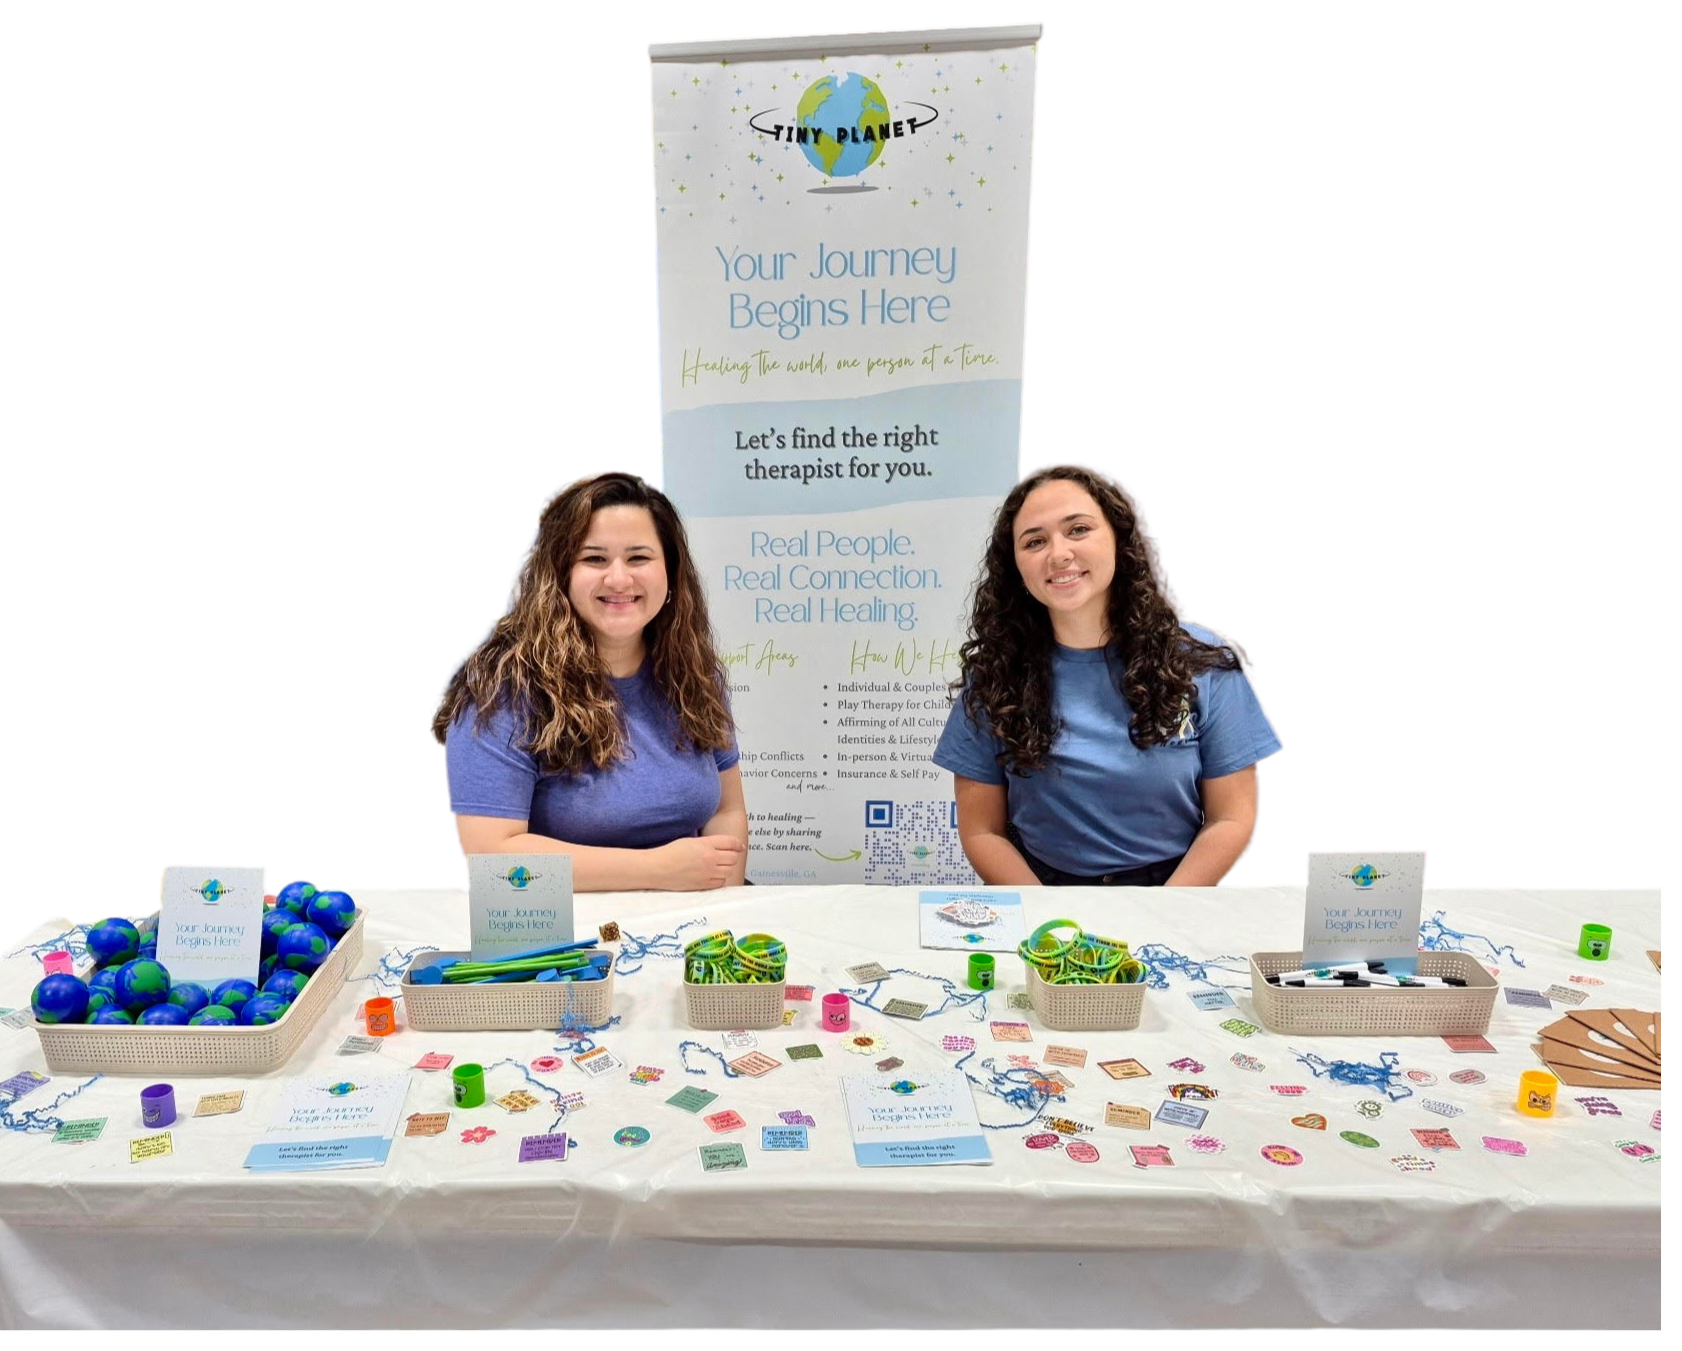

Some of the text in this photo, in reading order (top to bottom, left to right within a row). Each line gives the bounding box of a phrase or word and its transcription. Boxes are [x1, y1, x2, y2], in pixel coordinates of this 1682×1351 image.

[774, 117, 917, 145] TINY PLANET
[715, 243, 956, 284] Your Journey
[729, 289, 951, 340] Begins Here
[682, 347, 751, 388] Healing
[787, 351, 828, 375] world,
[836, 358, 860, 370] one
[867, 357, 914, 377] person
[943, 355, 954, 365] a
[735, 424, 939, 452] Let's find the right
[744, 457, 932, 484] therapist for you.
[751, 528, 915, 563] Real People.
[724, 563, 942, 591] Real Connection.
[754, 596, 919, 631] Real Healing.
[755, 639, 798, 676] Areas
[850, 638, 888, 675] How
[894, 637, 923, 676] We
[838, 682, 946, 695] Individual & Couples
[837, 699, 952, 712] Play Therapy for Child
[837, 717, 946, 730] Affirming of All Cultu
[837, 734, 886, 745] Identities
[888, 734, 897, 745] &
[739, 750, 805, 764] hip Conflicts
[837, 752, 933, 764] In-person & Virtua
[770, 768, 818, 779] Concerns
[837, 769, 940, 781] Insurance & Self Pay
[786, 779, 803, 794] and
[767, 812, 803, 824] healing
[755, 827, 771, 836] else
[773, 827, 784, 838] by
[786, 827, 822, 839] sharing
[766, 843, 787, 851] Scan
[790, 842, 812, 851] here.
[803, 870, 817, 878] GA
[486, 907, 556, 920] Your Journey
[1324, 907, 1402, 919] Your Journey
[175, 922, 244, 937] Your Journey
[488, 919, 554, 933] Begins Here
[1325, 919, 1398, 933] Begins Here
[176, 935, 241, 949] Begins Here
[324, 1106, 374, 1114] Journey
[902, 1104, 952, 1113] Journey
[289, 1114, 332, 1124] Begins
[872, 1113, 916, 1123] Begins
[1064, 1118, 1095, 1132] BELIEVE
[329, 1144, 348, 1152] right
